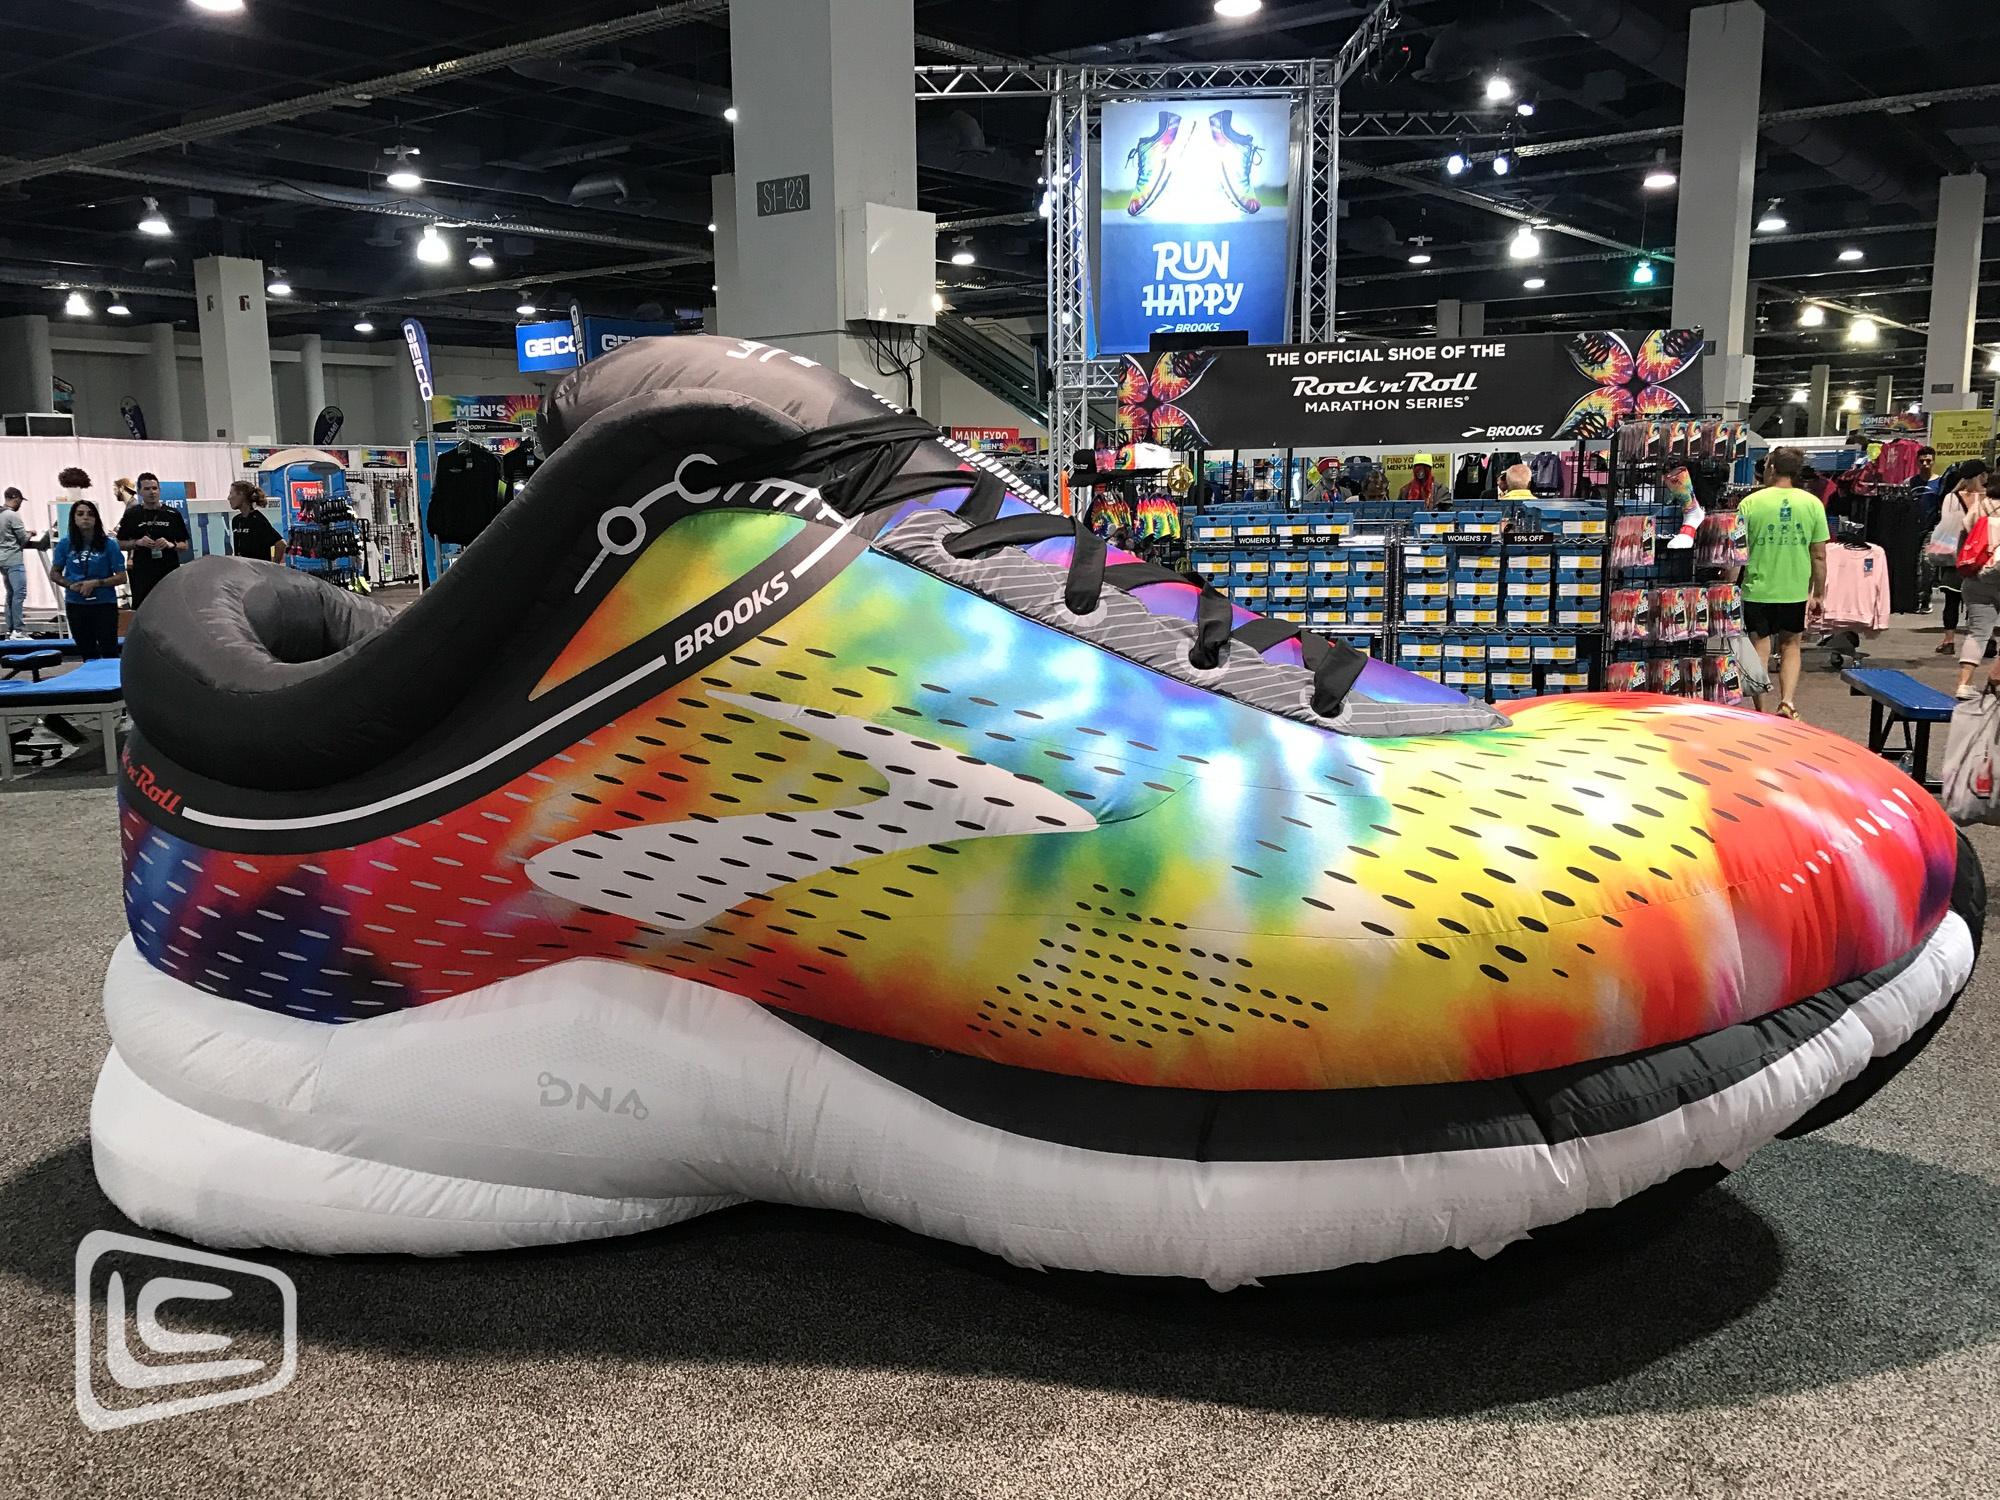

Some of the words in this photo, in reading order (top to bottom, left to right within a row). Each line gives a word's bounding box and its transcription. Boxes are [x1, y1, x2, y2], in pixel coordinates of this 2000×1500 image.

[763, 178, 804, 213] S1-123
[1152, 240, 1230, 281] RUN
[1141, 282, 1244, 317] HAPPY
[570, 304, 586, 367] GEIC
[1175, 322, 1220, 333] BROOKS
[403, 323, 434, 401] GEICO
[1267, 352, 1300, 366] THE
[1304, 349, 1384, 365] OFFICIAL
[1388, 346, 1436, 361] SHOE
[1441, 345, 1465, 359] OF
[1470, 343, 1506, 357] THE
[456, 404, 507, 417] MEN'S
[1305, 399, 1399, 413] MARATHON
[955, 431, 980, 441] MAIN
[983, 431, 1009, 440] EXPO
[1486, 425, 1544, 437] BROOKS
[1936, 442, 1954, 450] FIND
[1955, 441, 1978, 449] YOUR
[166, 500, 184, 508] GIFT
[674, 570, 789, 665] BROOKS
[537, 1071, 649, 1120] DNA
